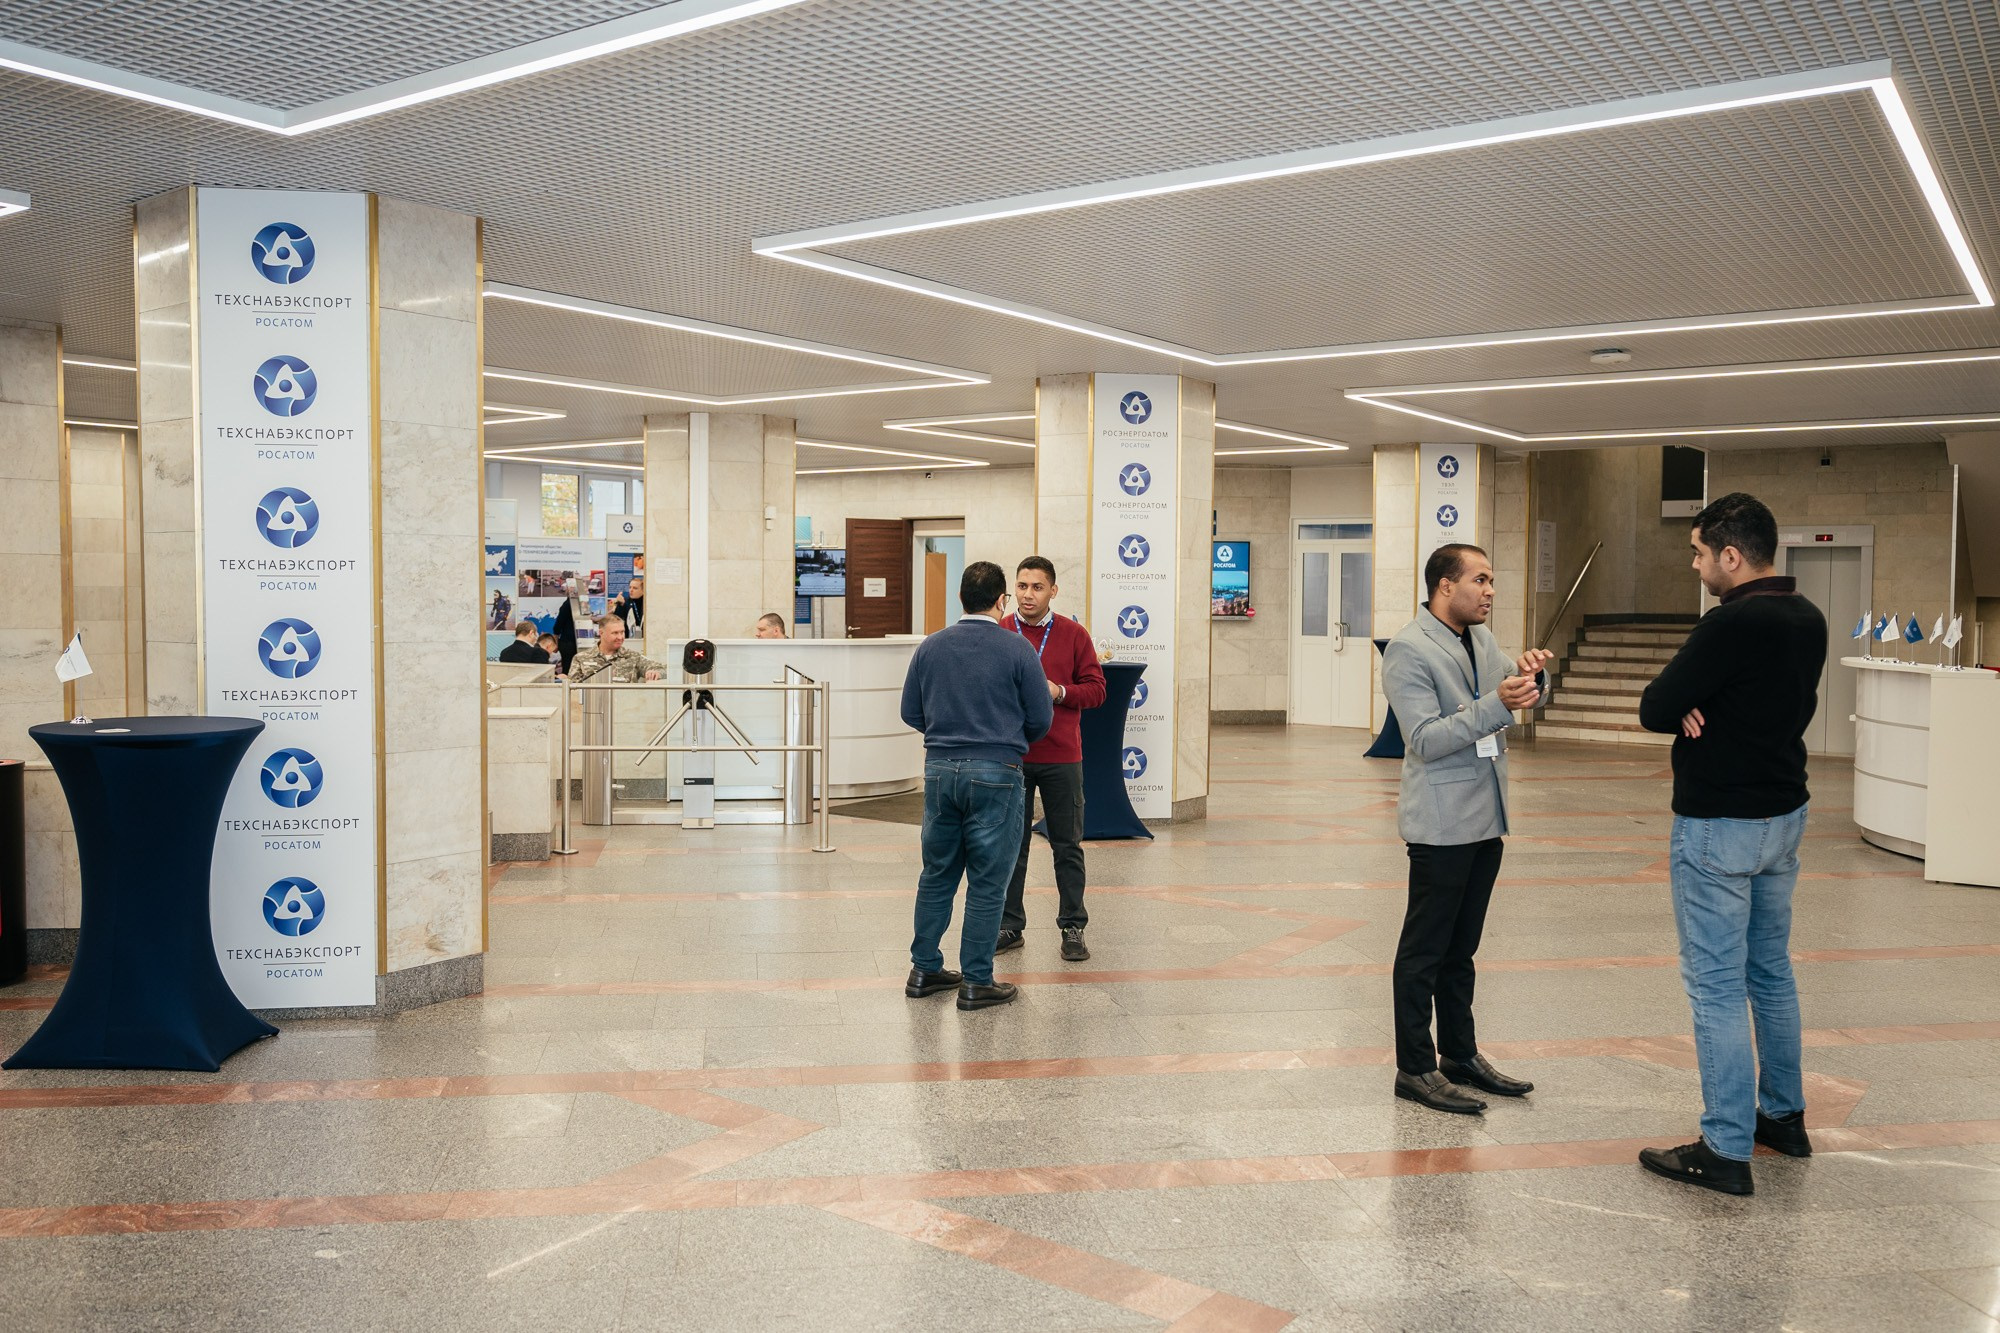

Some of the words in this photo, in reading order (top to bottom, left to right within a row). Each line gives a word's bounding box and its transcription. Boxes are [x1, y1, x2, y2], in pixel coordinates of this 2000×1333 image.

[215, 294, 352, 308] ТЕХСНАБЭКСПОРТ
[256, 317, 313, 328] РОСАТОМ
[216, 427, 354, 440] ТЕХСНАБЭКСПОРТ
[1102, 430, 1168, 438] РОСЭНЕРГОАТОМ
[257, 450, 315, 460] РОСАТОМ
[219, 559, 356, 571] ТЕХСНАБЭКСПОРТ
[260, 581, 317, 591] РОСАТОМ
[221, 689, 358, 701] ТЕХСНАБЭКСПОРТ
[262, 711, 319, 721] РОСАТОМ
[223, 818, 360, 831] ТЕХСНАБЭКСПОРТ
[264, 840, 321, 850] РОСАТОМ
[226, 946, 361, 960] ТЕХСНАБЭКСПОРТ
[266, 968, 323, 979] РОСАТОМ
